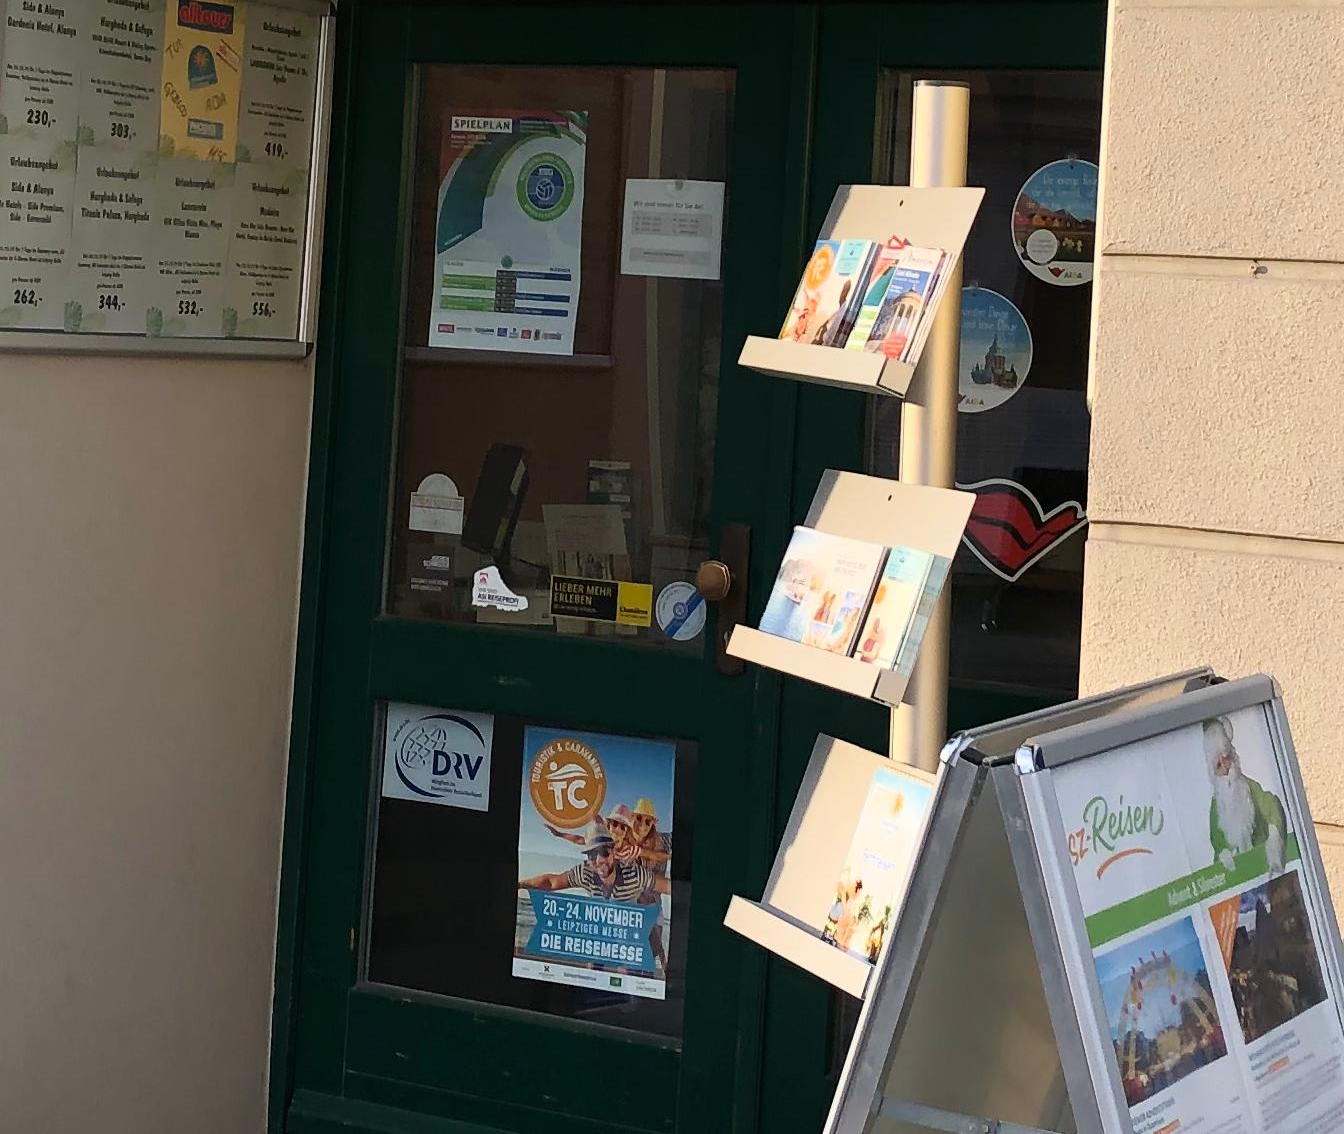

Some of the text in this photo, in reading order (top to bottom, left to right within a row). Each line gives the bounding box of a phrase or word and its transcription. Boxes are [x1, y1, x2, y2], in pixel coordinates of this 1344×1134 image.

[38, 3, 43, 13] &
[128, 20, 133, 31] &
[27, 109, 56, 128] 230,-
[454, 119, 510, 130] SPIELPLAN
[110, 123, 136, 141] 303,-
[265, 142, 288, 159] 419,-
[27, 182, 31, 193] &
[119, 193, 123, 204] &
[14, 289, 42, 306] 262,-
[98, 295, 125, 311] 344,-
[178, 300, 203, 316] 532,-
[252, 302, 276, 317] 556,-
[554, 582, 612, 597] LIEBER MEHR
[488, 594, 519, 605] REISEPROFI
[553, 592, 593, 606] ERLEBEN
[432, 749, 483, 780] DRV
[532, 741, 603, 783] TOURISTIK & CARAVANING
[548, 779, 588, 810] TC
[584, 905, 643, 928] NOVEMBER
[557, 921, 628, 939] LEIPZIGER MESSE
[541, 933, 643, 962] DIE REISEMESSE
